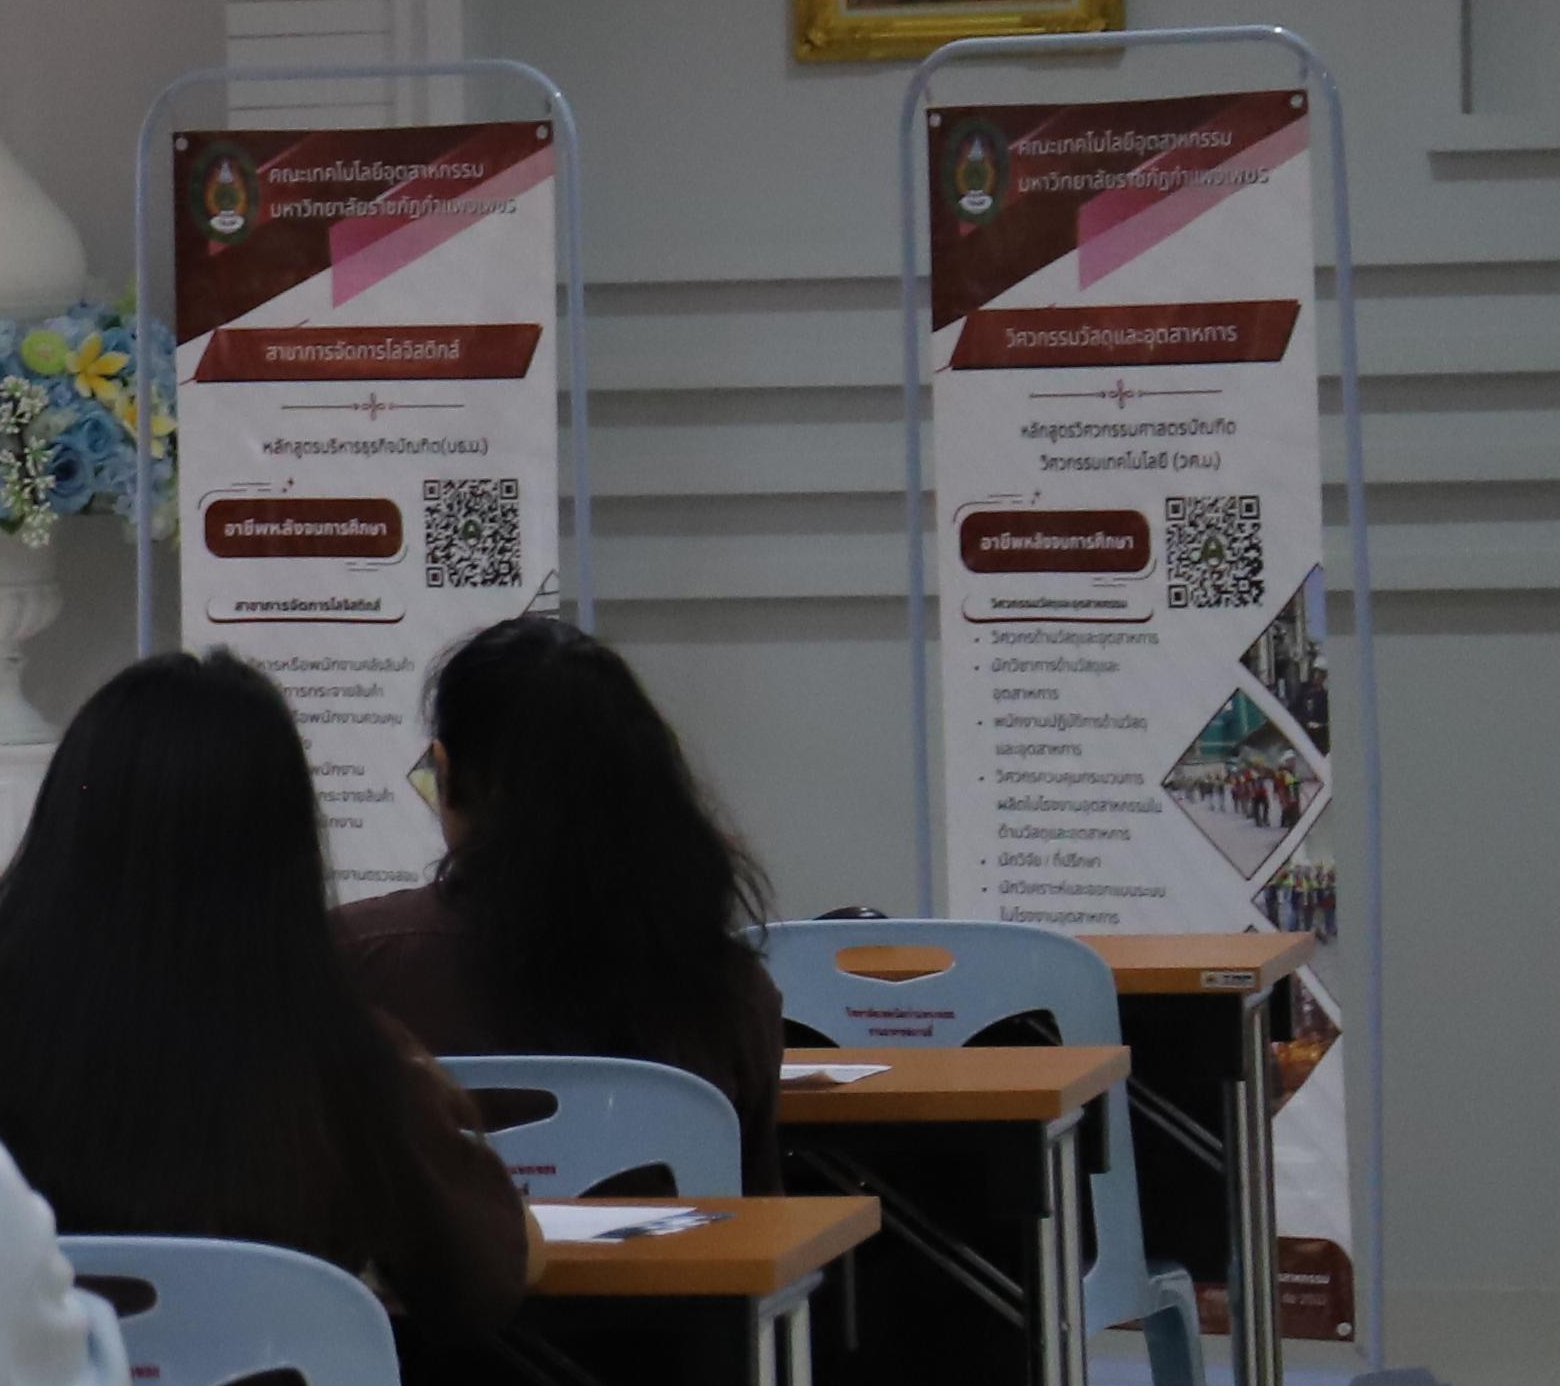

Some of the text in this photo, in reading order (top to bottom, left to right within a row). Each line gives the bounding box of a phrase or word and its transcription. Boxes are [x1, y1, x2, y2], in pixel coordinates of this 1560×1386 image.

[1018, 129, 1233, 156] คณะเทคโนโลยีอุตสาหกรรม
[268, 161, 485, 185] คณะเทคโนโลยีอุตสาหกรรม
[1005, 324, 1239, 351] วิศวกรรมวัสดุและอุตสาหการ
[265, 338, 461, 363] สาขาการจัดการโลจิสติกส์
[223, 516, 388, 538] อาชีพหลังจบการศึกษา
[979, 530, 1135, 552] อาชีพหลังจบการศึกษา
